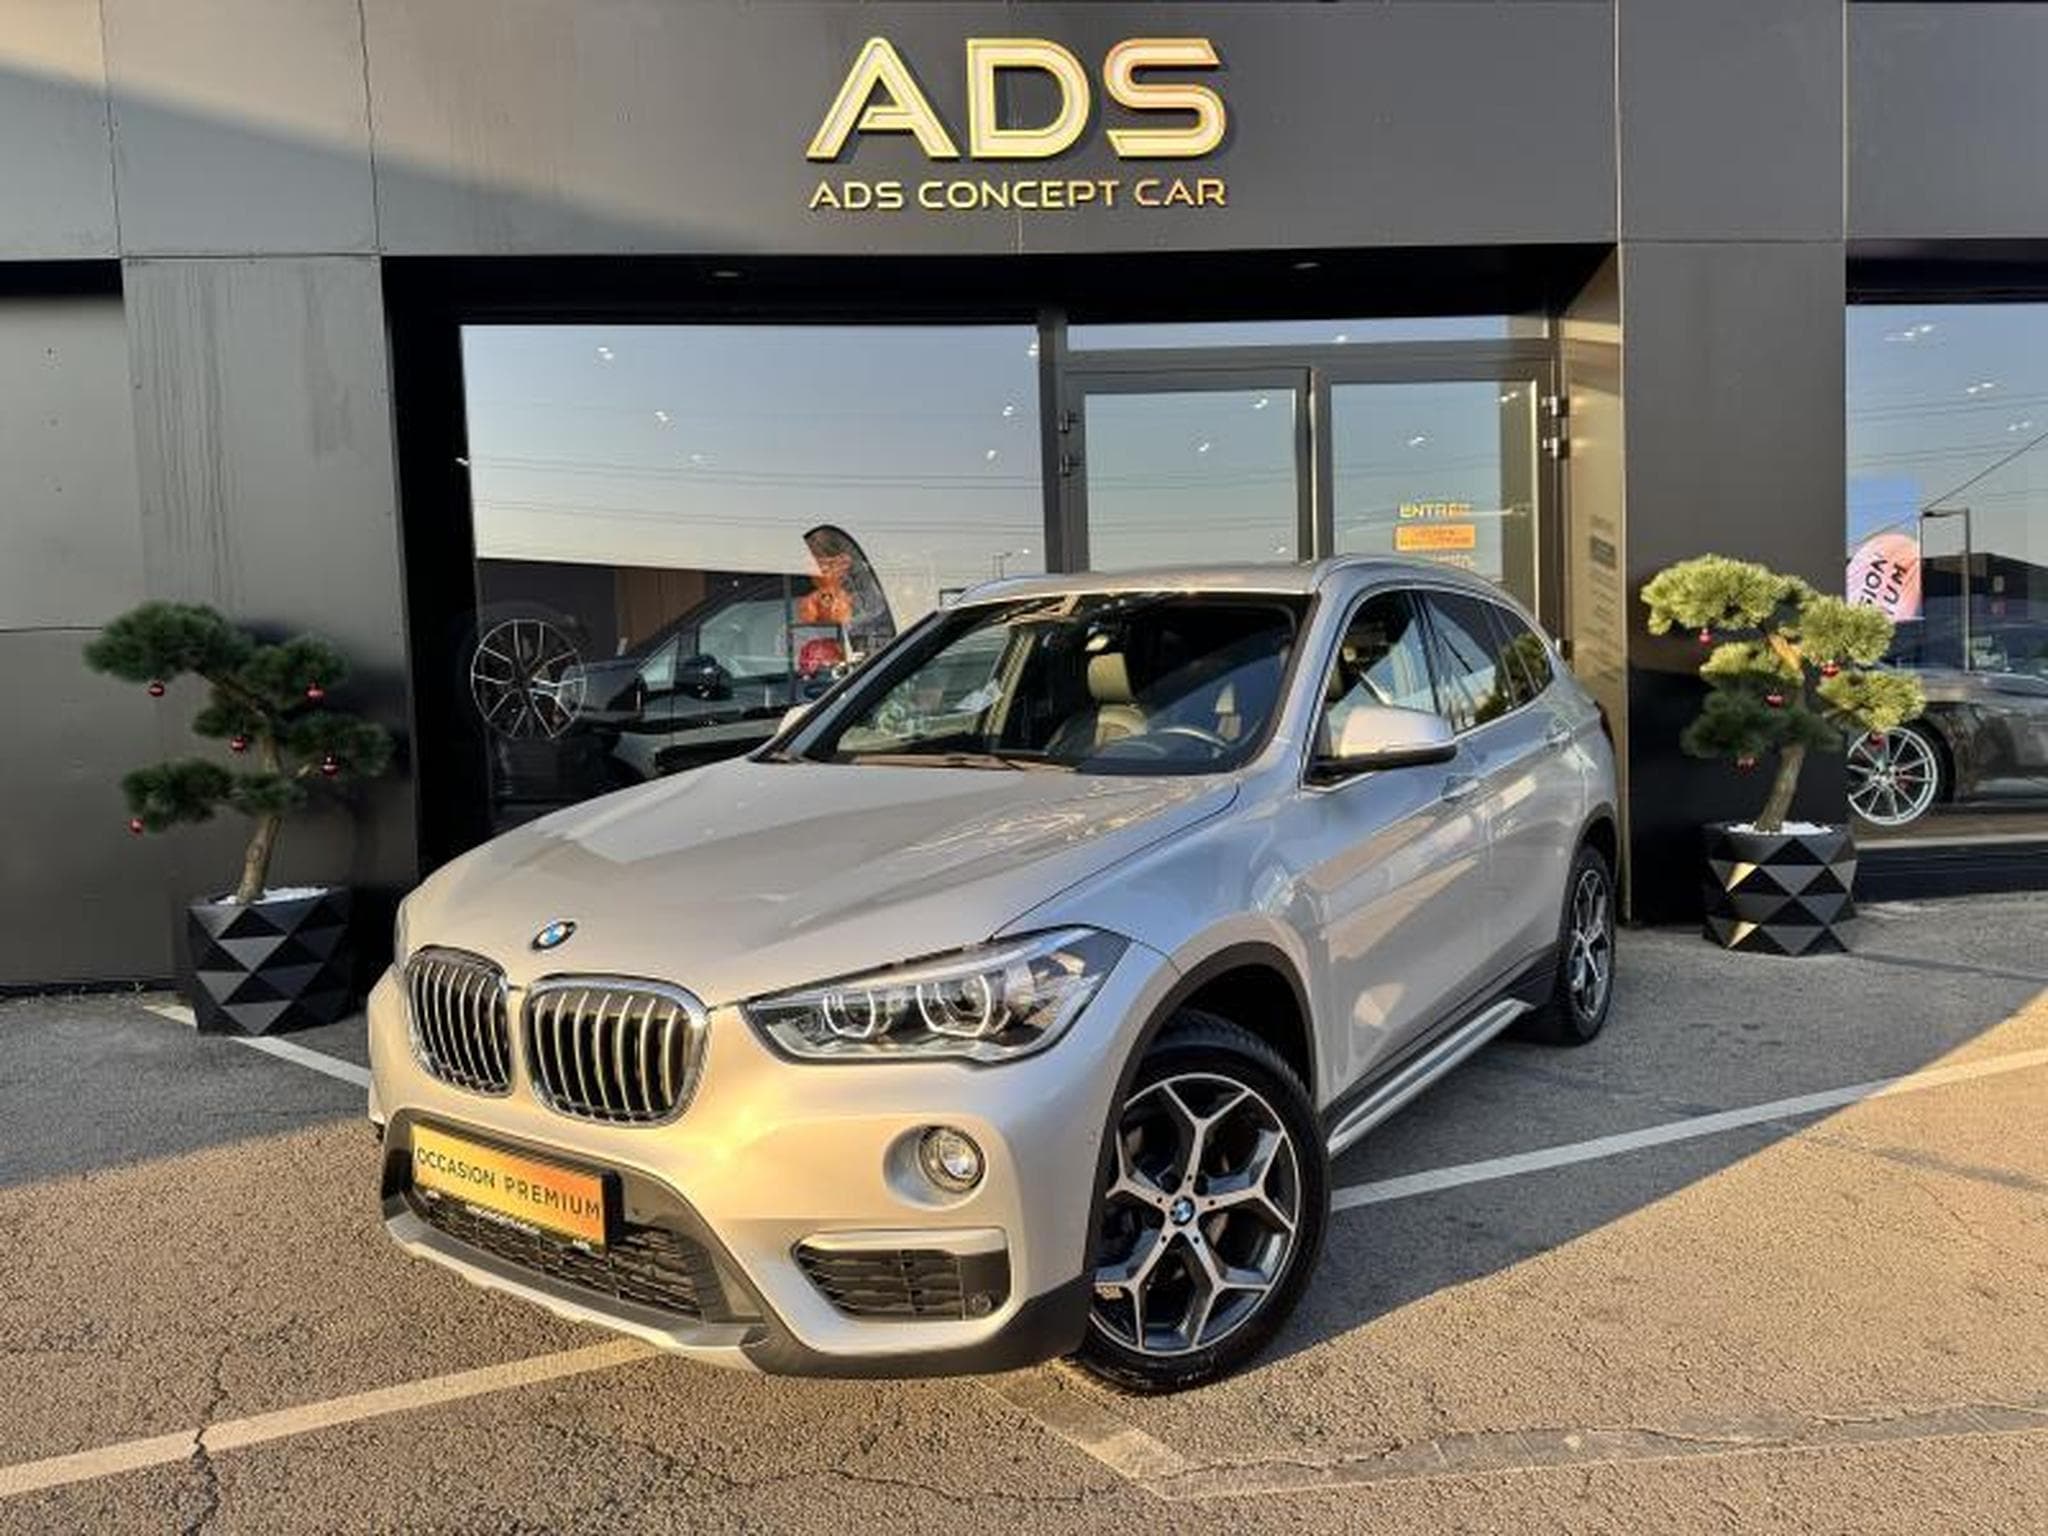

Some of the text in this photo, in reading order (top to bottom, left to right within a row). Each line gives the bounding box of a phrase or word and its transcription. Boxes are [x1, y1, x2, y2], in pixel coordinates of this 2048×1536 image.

[806, 37, 1226, 159] ADS
[808, 178, 1226, 209] ADS CONCEPT CAR
[415, 1148, 496, 1189] OCCASION
[504, 1176, 601, 1221] PREMIUM
